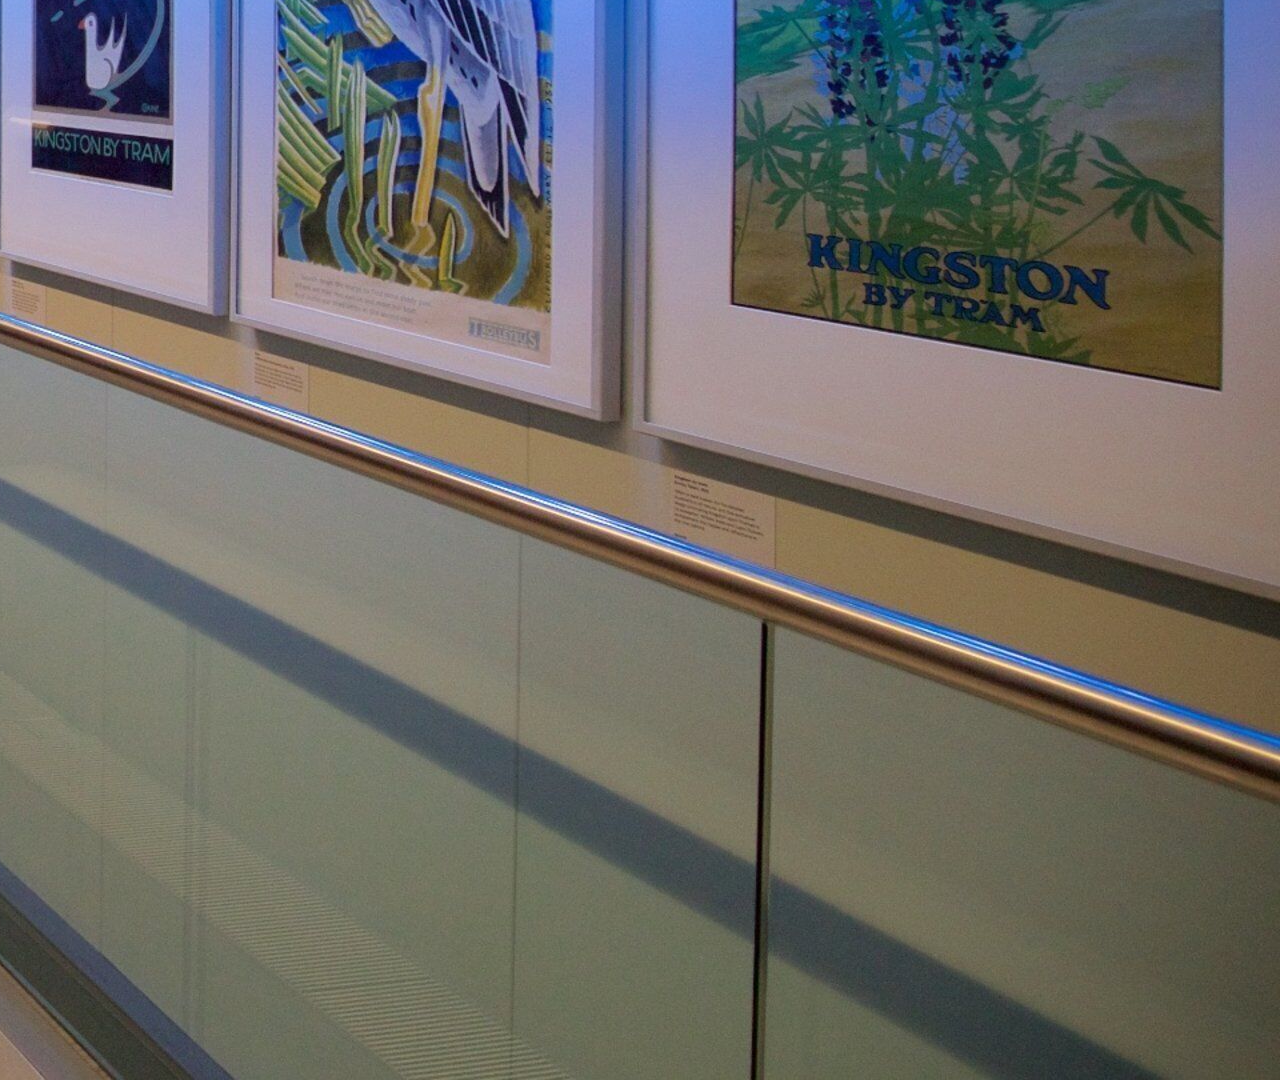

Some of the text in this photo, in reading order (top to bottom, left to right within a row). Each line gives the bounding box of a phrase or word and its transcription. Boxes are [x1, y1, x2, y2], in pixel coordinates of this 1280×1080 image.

[34, 129, 170, 165] KINGSTON BY TRAM
[806, 233, 1112, 310] KINGSTON
[863, 282, 1046, 332] BY TRAM
